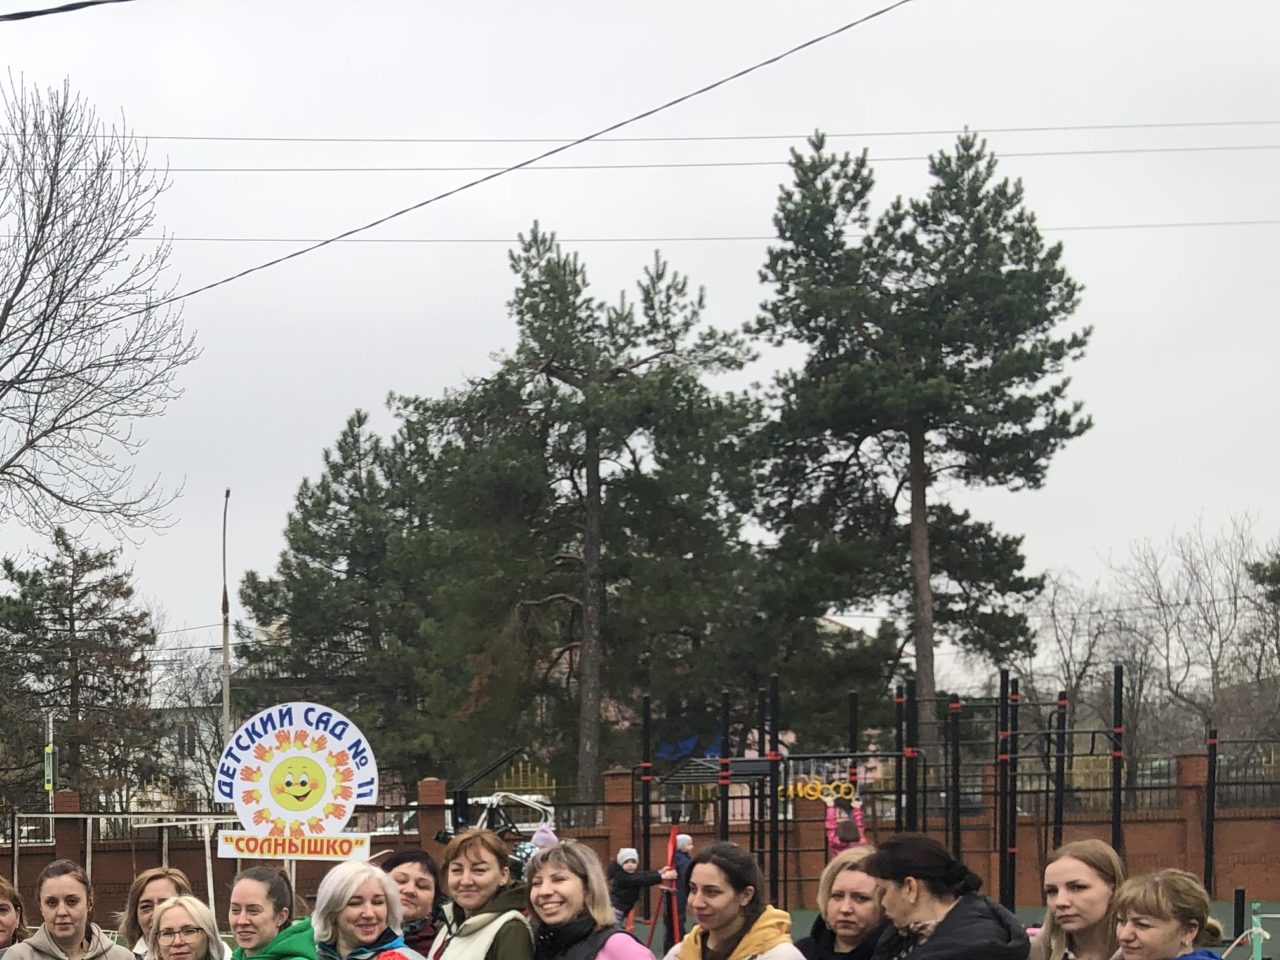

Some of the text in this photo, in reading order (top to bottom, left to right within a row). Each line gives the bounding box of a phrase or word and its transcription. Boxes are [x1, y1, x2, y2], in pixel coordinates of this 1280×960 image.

[217, 704, 375, 800] ДЕТСКИЙ САД № 11
